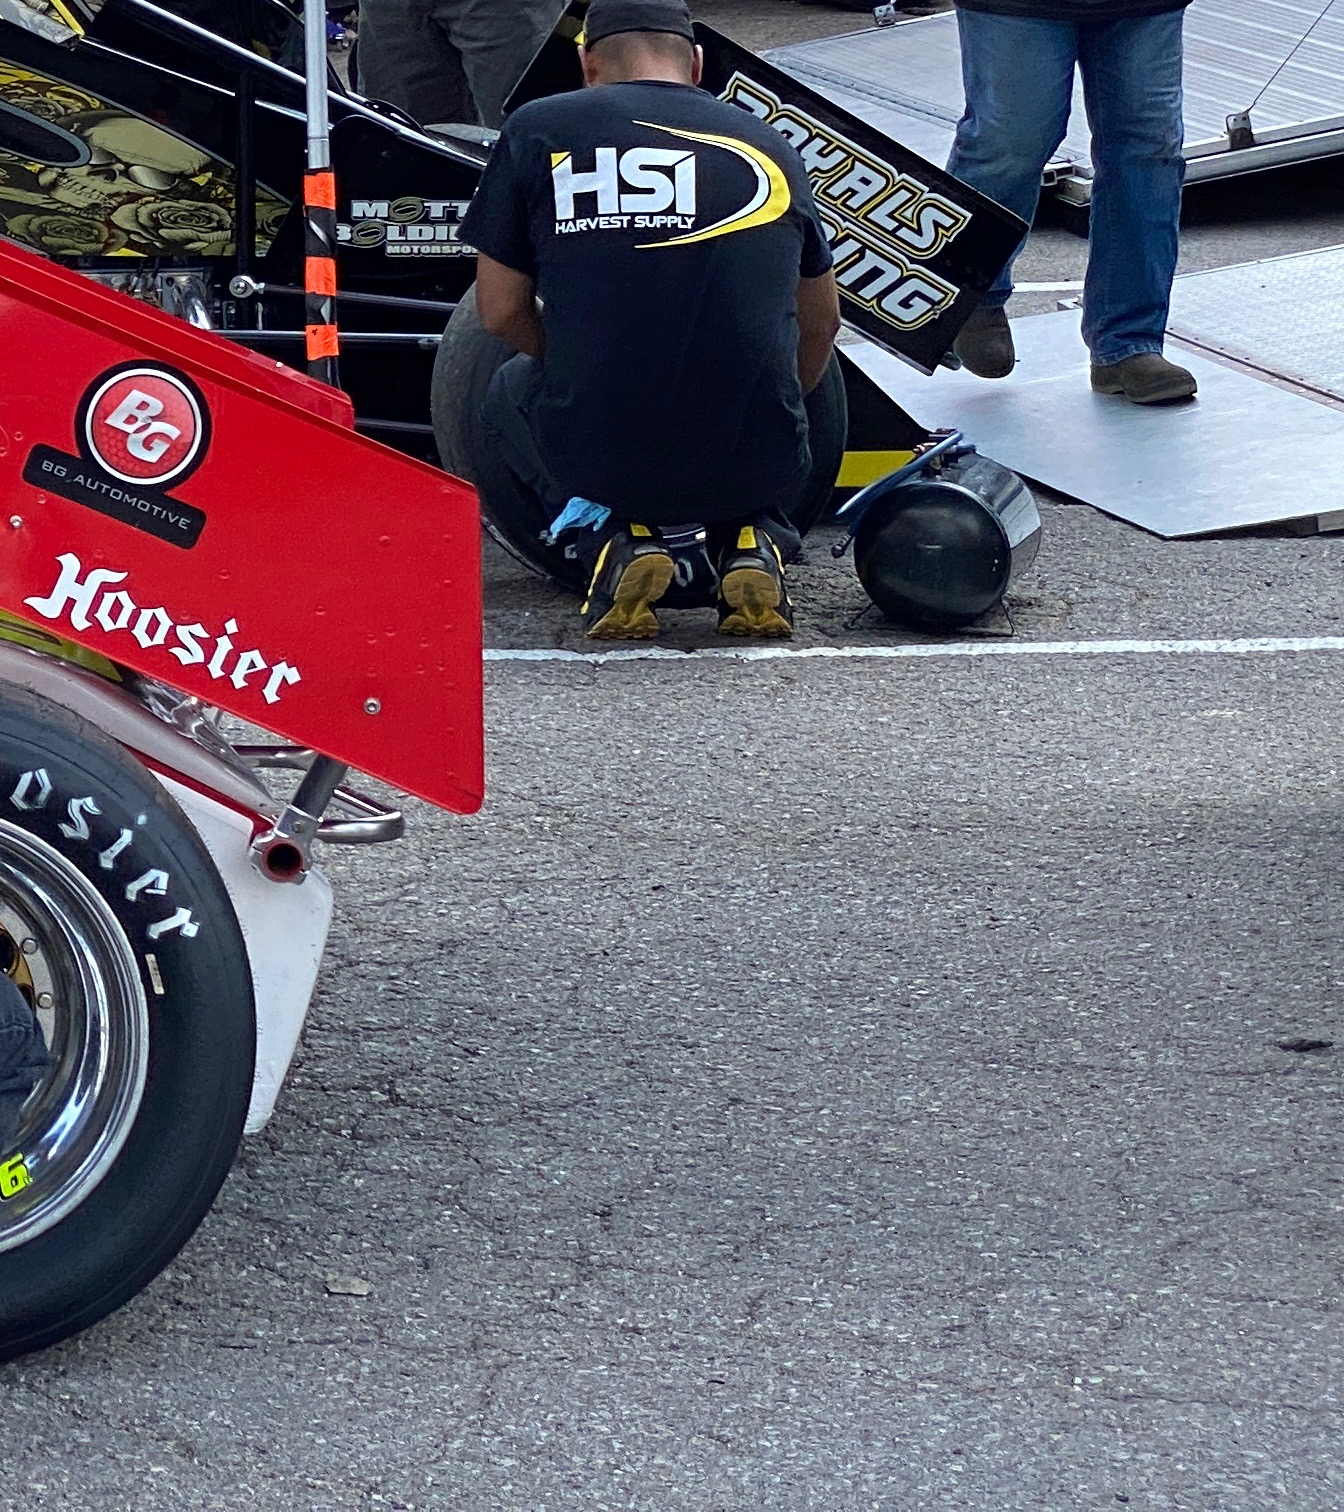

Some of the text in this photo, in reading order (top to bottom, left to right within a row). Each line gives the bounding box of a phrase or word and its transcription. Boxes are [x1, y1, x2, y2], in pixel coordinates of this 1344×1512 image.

[550, 146, 696, 221] HSI
[336, 220, 462, 247] BOLDI
[386, 244, 478, 254] MOTORSPO
[555, 215, 696, 235] HARVEST SUPPLY
[104, 389, 181, 463] BG
[40, 459, 191, 530] BG AUTOMOTIVE
[22, 552, 302, 705] Hoosier
